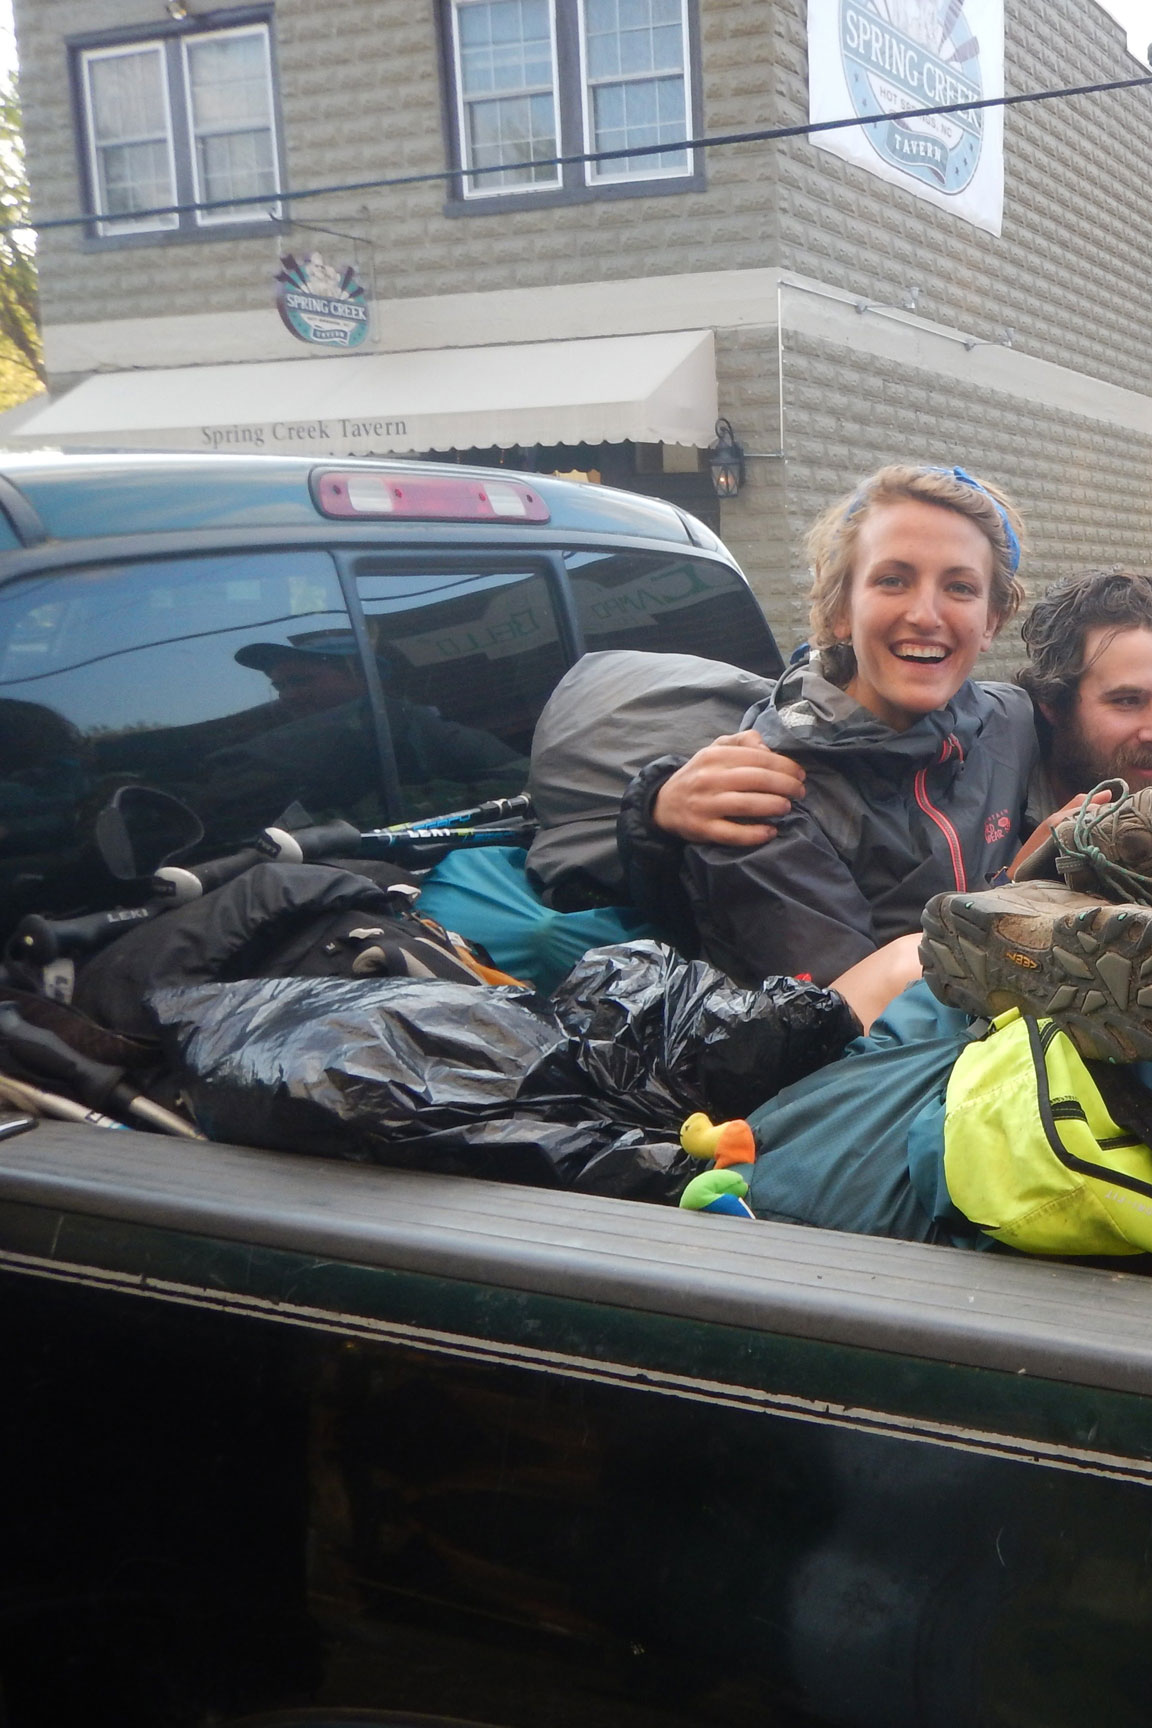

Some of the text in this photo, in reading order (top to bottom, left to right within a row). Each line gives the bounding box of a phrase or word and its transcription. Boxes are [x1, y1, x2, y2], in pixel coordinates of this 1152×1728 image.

[845, 9, 982, 130] SPRING CREEK
[894, 134, 942, 162] TAVERN
[286, 293, 329, 314] SPRING
[330, 301, 367, 321] CREEK
[201, 419, 407, 448] Spring Creek Tavern
[106, 908, 149, 923] LEKI
[1006, 952, 1038, 969] KEEN
